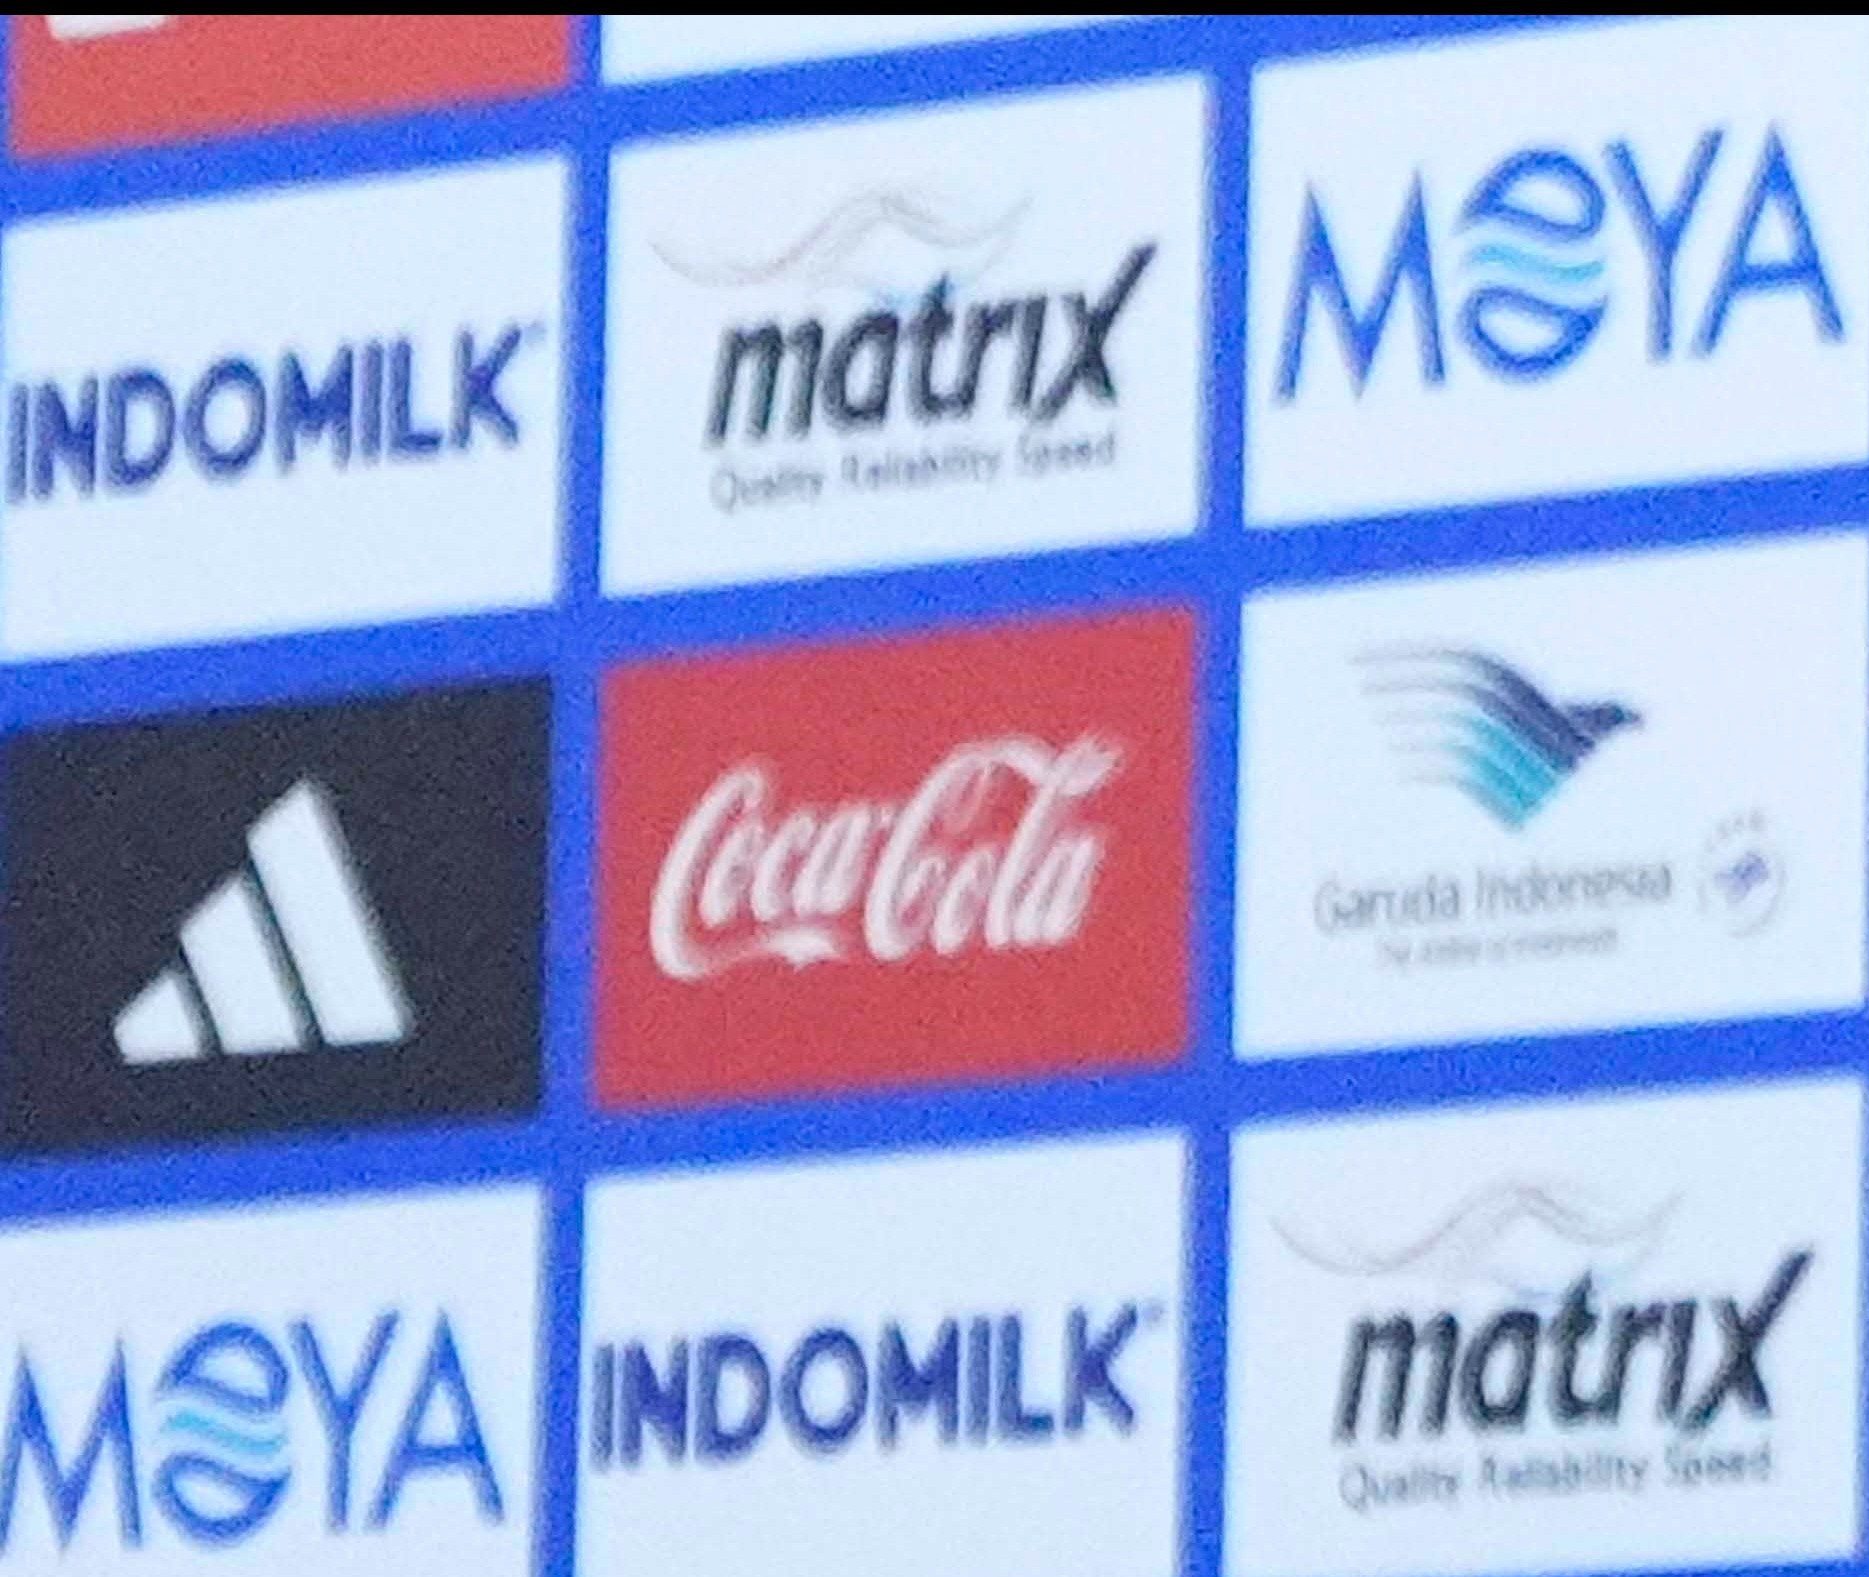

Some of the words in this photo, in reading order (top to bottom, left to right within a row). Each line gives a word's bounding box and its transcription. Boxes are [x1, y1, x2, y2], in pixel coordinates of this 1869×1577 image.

[702, 244, 1158, 446] matrix
[1274, 125, 1846, 402] MOYA
[8, 325, 520, 502] INDOMILK
[1313, 871, 1462, 936] Garuda
[1474, 860, 1674, 920] Indonesia
[590, 1303, 1138, 1468] INDOMILK
[1333, 1248, 1814, 1446] matrix
[1479, 1449, 1649, 1500] Reliability
[1664, 1437, 1773, 1490] Speed
